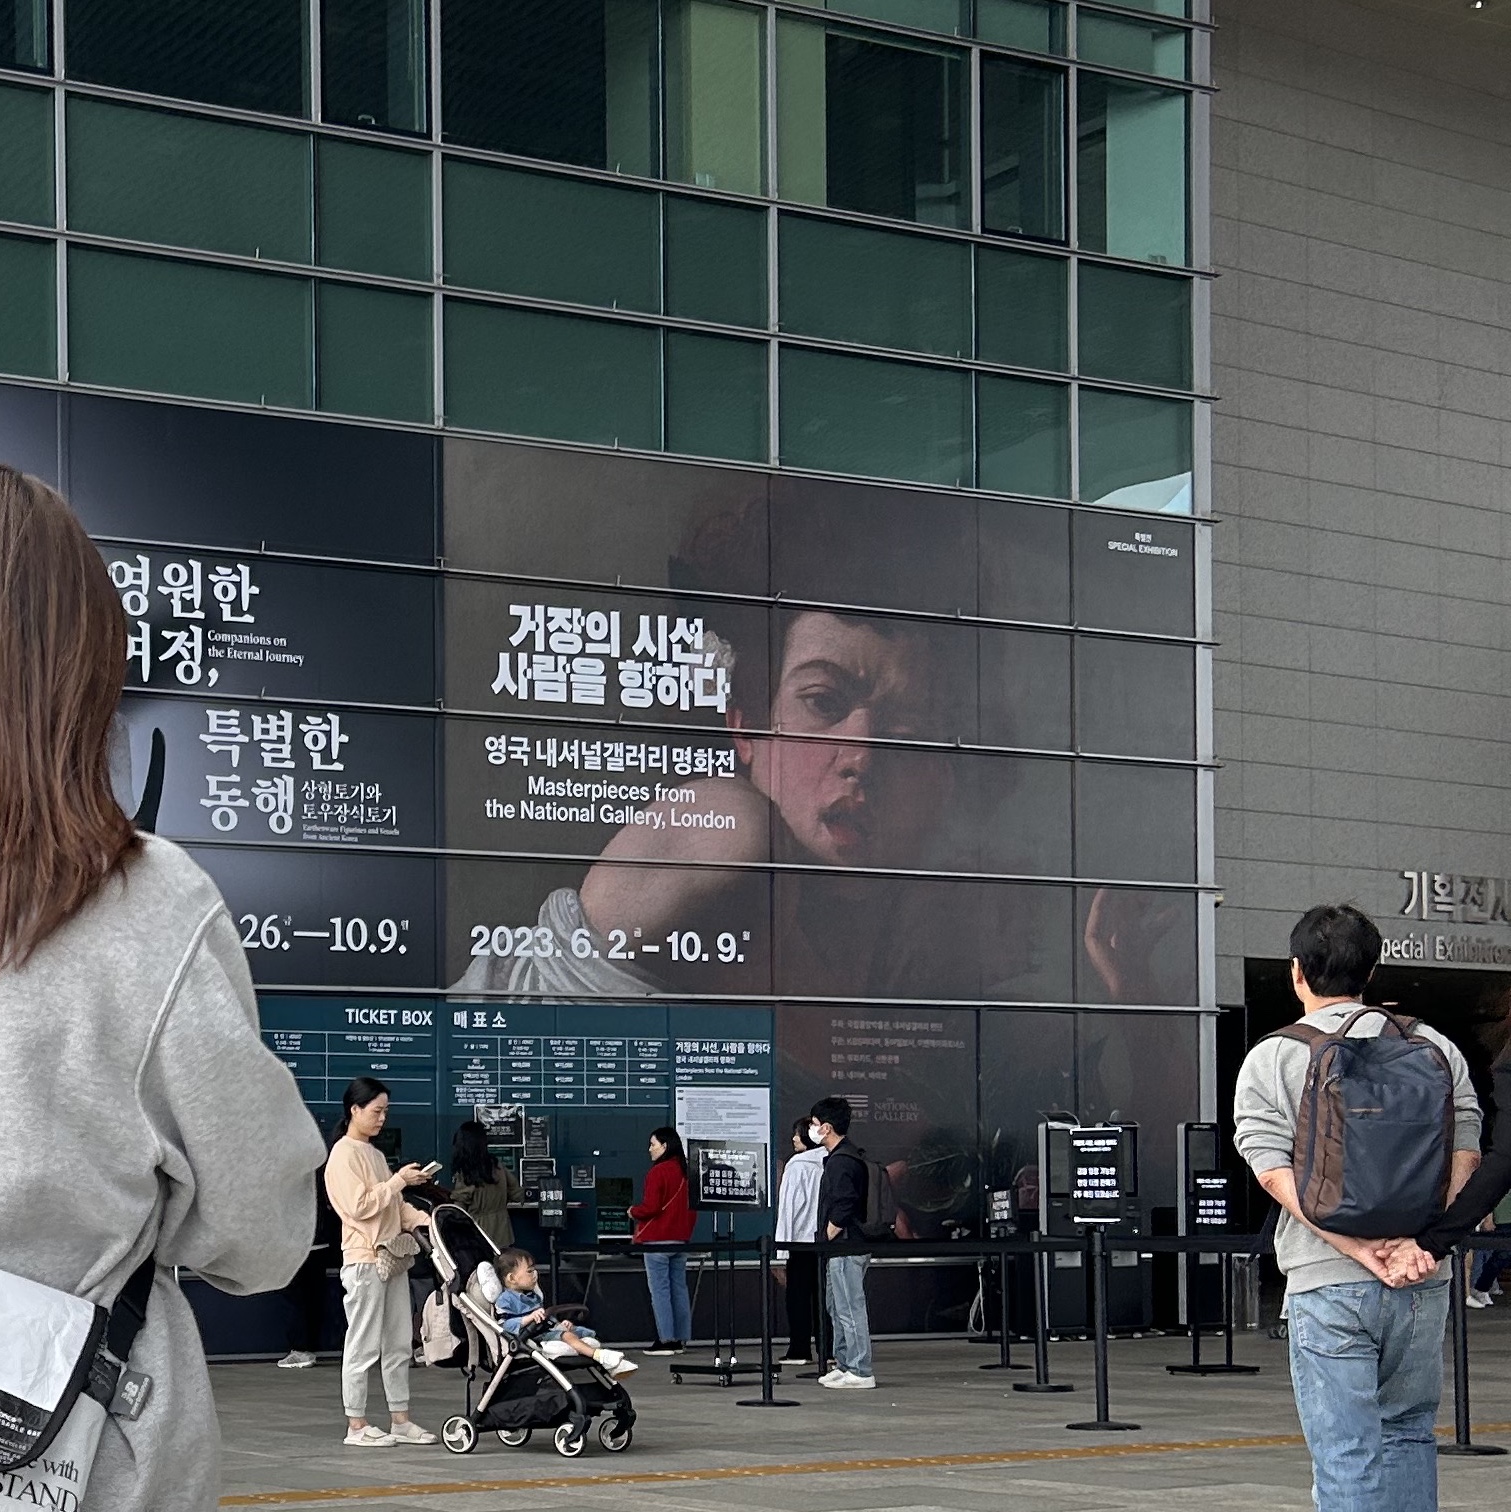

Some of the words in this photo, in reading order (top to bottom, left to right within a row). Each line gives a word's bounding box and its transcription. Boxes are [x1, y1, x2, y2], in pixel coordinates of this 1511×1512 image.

[1107, 541, 1138, 553] SPECIAL
[1138, 544, 1179, 557] EXHIBITION
[107, 554, 260, 623] 영원한
[207, 629, 272, 647] Companions
[273, 637, 287, 648] on
[508, 604, 620, 658] 거장의
[632, 615, 717, 668] 시선,
[207, 645, 225, 659] the
[226, 648, 264, 662] Eternal
[265, 650, 305, 667] Journey
[490, 652, 607, 706] 사람을
[618, 659, 731, 714] 향하다
[199, 708, 349, 771] 특별한
[484, 735, 531, 767] 영국
[535, 738, 668, 775] 내셔널갤러리
[671, 746, 736, 778] 명화전
[300, 780, 383, 804] 상형토기와
[527, 775, 650, 801] Masterpieces
[654, 782, 696, 803] from
[199, 774, 295, 835] 동행
[300, 802, 398, 826] 토우장식토기
[484, 799, 515, 819] the
[520, 800, 595, 823] National
[600, 804, 666, 830] Gallery,
[671, 808, 736, 830] London
[470, 925, 562, 959] 2023.
[571, 928, 600, 960] 6.
[667, 930, 709, 962] 10.
[1380, 933, 1428, 965] pecial
[344, 1008, 398, 1025] TICKET
[402, 1010, 433, 1026] BOX
[874, 1111, 919, 1121] GALLERY
[42, 1458, 79, 1484] with
